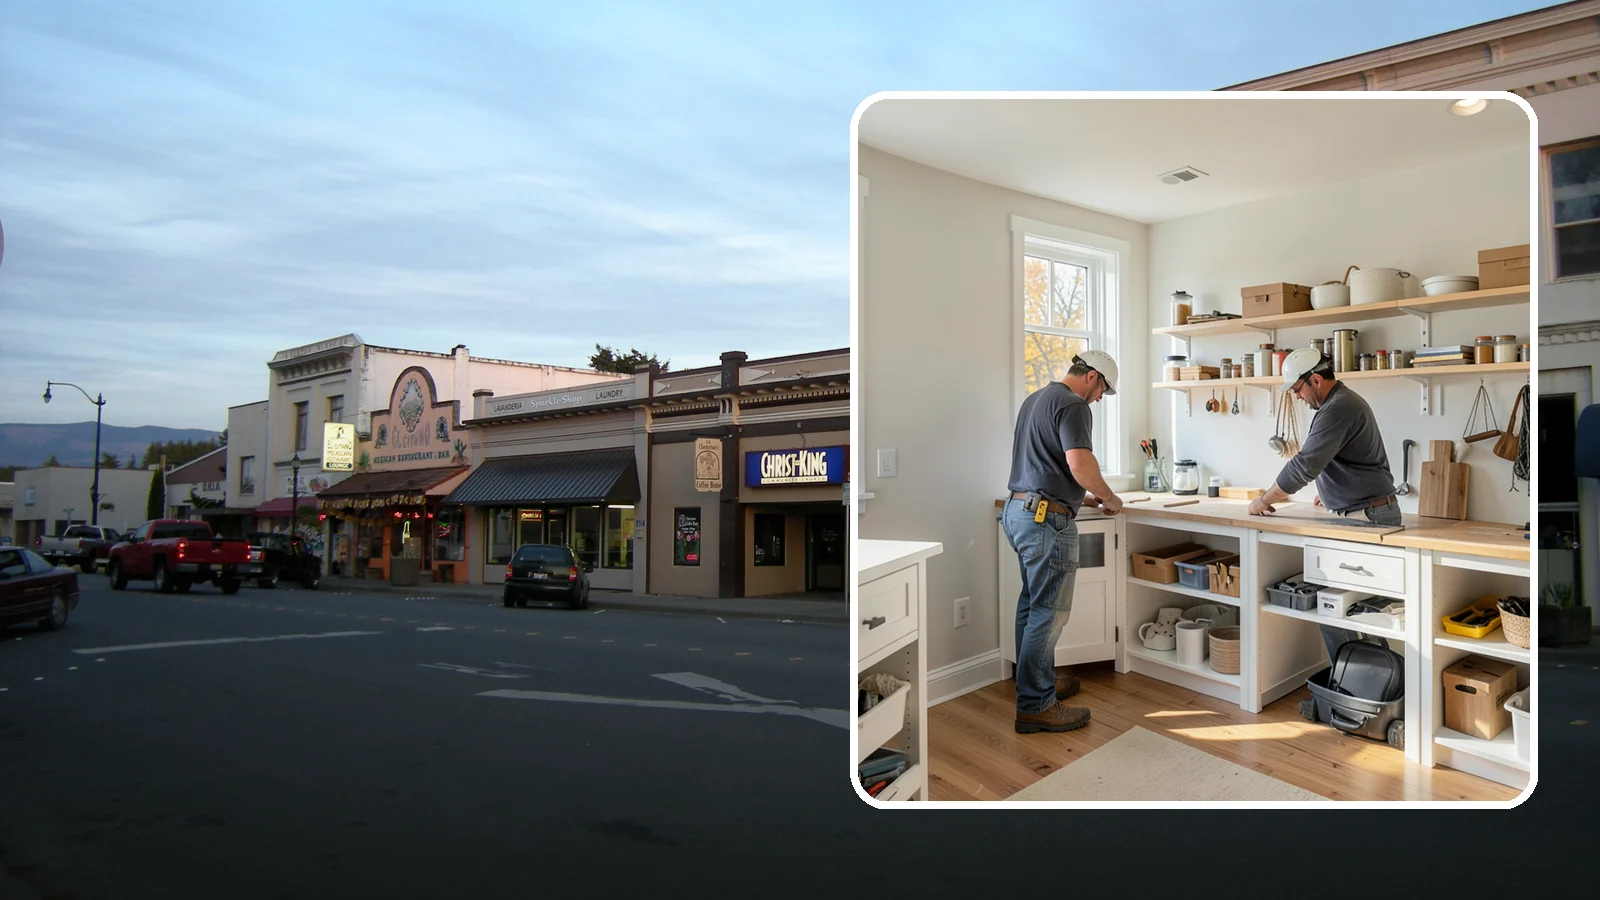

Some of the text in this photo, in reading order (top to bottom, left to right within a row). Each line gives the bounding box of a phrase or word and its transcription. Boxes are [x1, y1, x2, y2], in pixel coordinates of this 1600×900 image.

[493, 389, 624, 412] LAVANDERIA Sparkle Shop LAUNDRY
[397, 451, 433, 462] RESTAURANT
[438, 450, 450, 459] BAR
[761, 450, 827, 478] CHRIST KING
